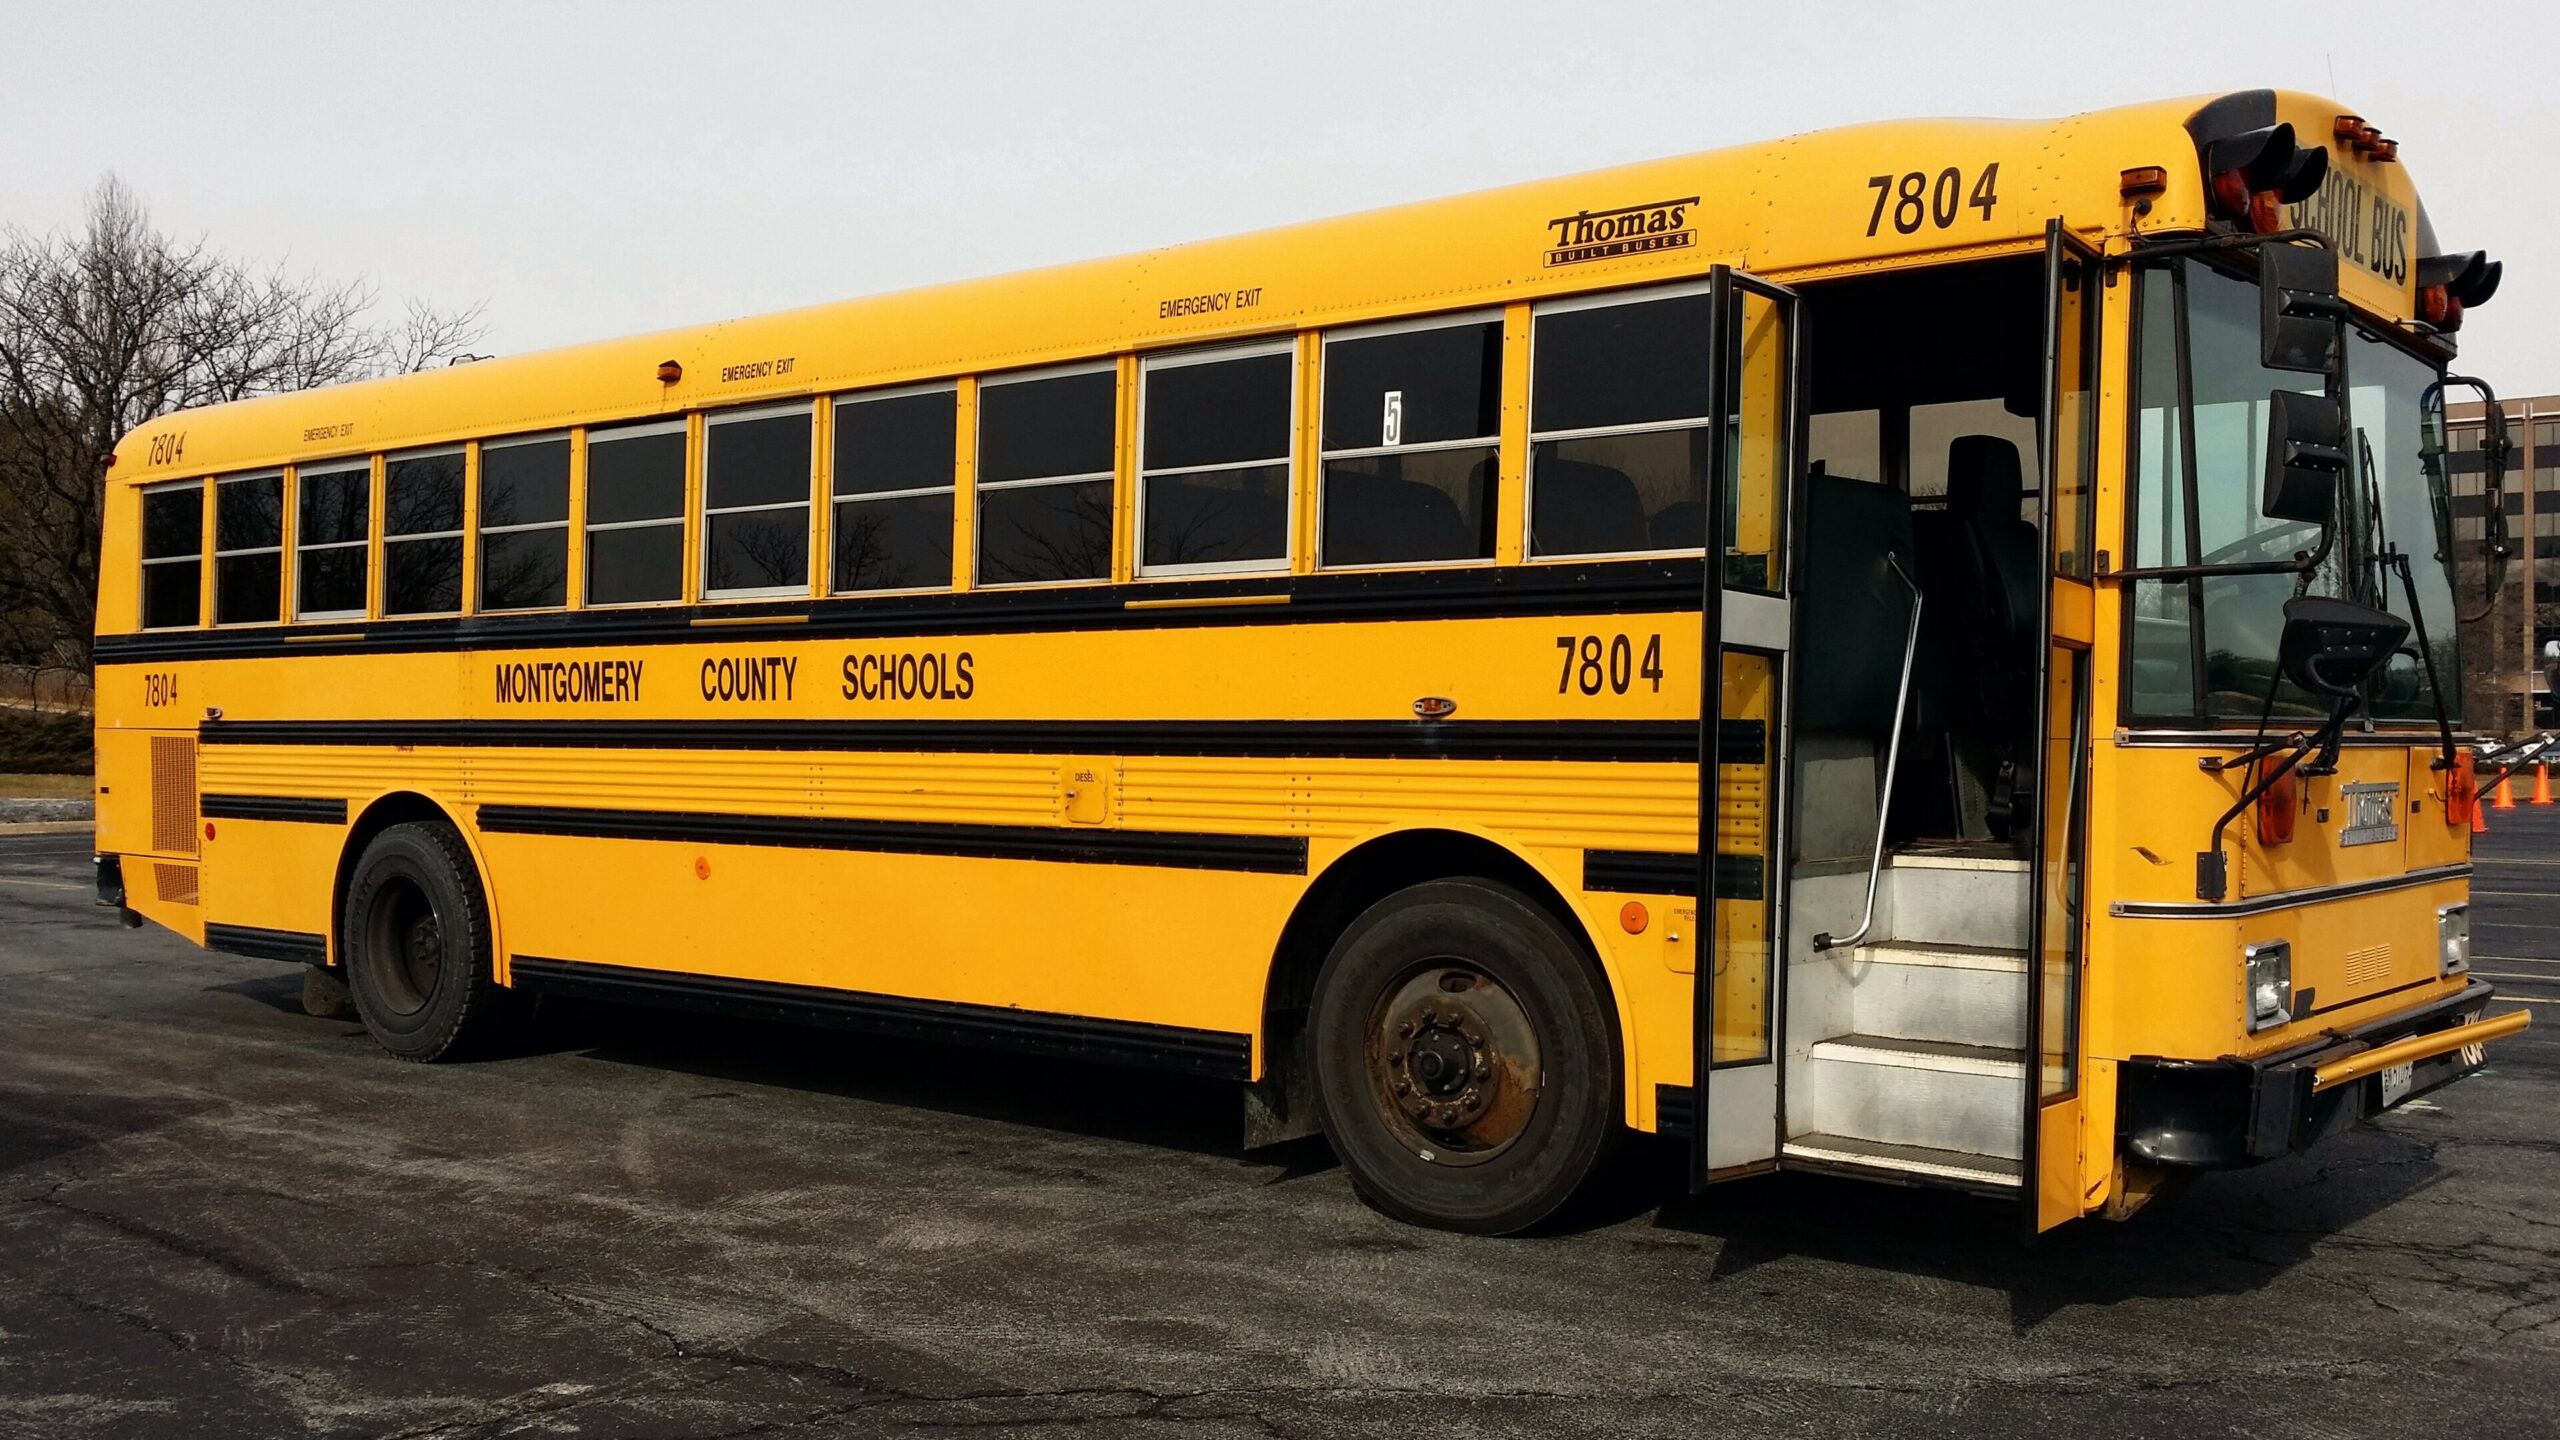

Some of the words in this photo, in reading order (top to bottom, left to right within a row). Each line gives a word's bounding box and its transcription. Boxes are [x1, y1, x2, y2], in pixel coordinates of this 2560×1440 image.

[1866, 162, 1999, 237] 7804
[1547, 196, 1700, 247] Thomas
[1555, 246, 1609, 262] BUILT
[1622, 234, 1684, 252] BUSES
[2371, 195, 2407, 286] BUS
[1160, 293, 1231, 318] EMERGENCY
[1236, 288, 1262, 309] EXIT
[723, 364, 773, 382] EMERGENCY
[776, 358, 795, 375] EXIT
[303, 425, 339, 442] EMERGENCY
[340, 423, 354, 437] EXIT
[1386, 395, 1399, 442] 5
[148, 431, 187, 467] 7804
[496, 660, 644, 703] MONTGOMERY
[702, 657, 798, 702] COUNTY
[842, 653, 974, 701] SCHOOLS
[1557, 634, 1663, 696] 7804
[145, 673, 178, 707] 7804
[1074, 771, 1095, 783] DIESEL
